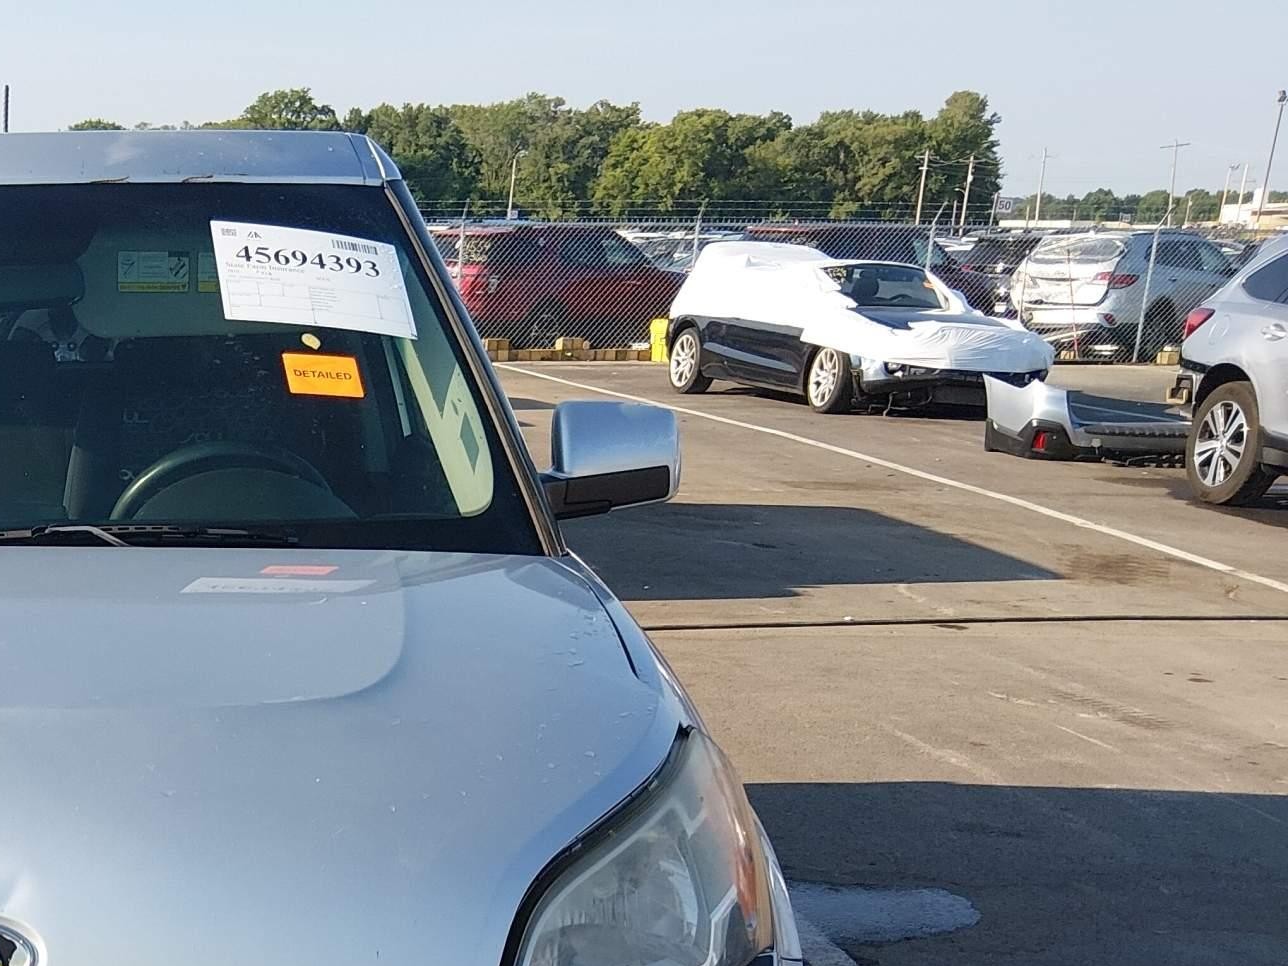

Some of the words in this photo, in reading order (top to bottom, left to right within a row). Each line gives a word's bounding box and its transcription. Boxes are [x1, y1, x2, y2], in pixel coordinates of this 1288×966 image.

[998, 200, 1012, 210] 50
[235, 245, 380, 278] 45694393
[293, 368, 352, 381] DETAILED
